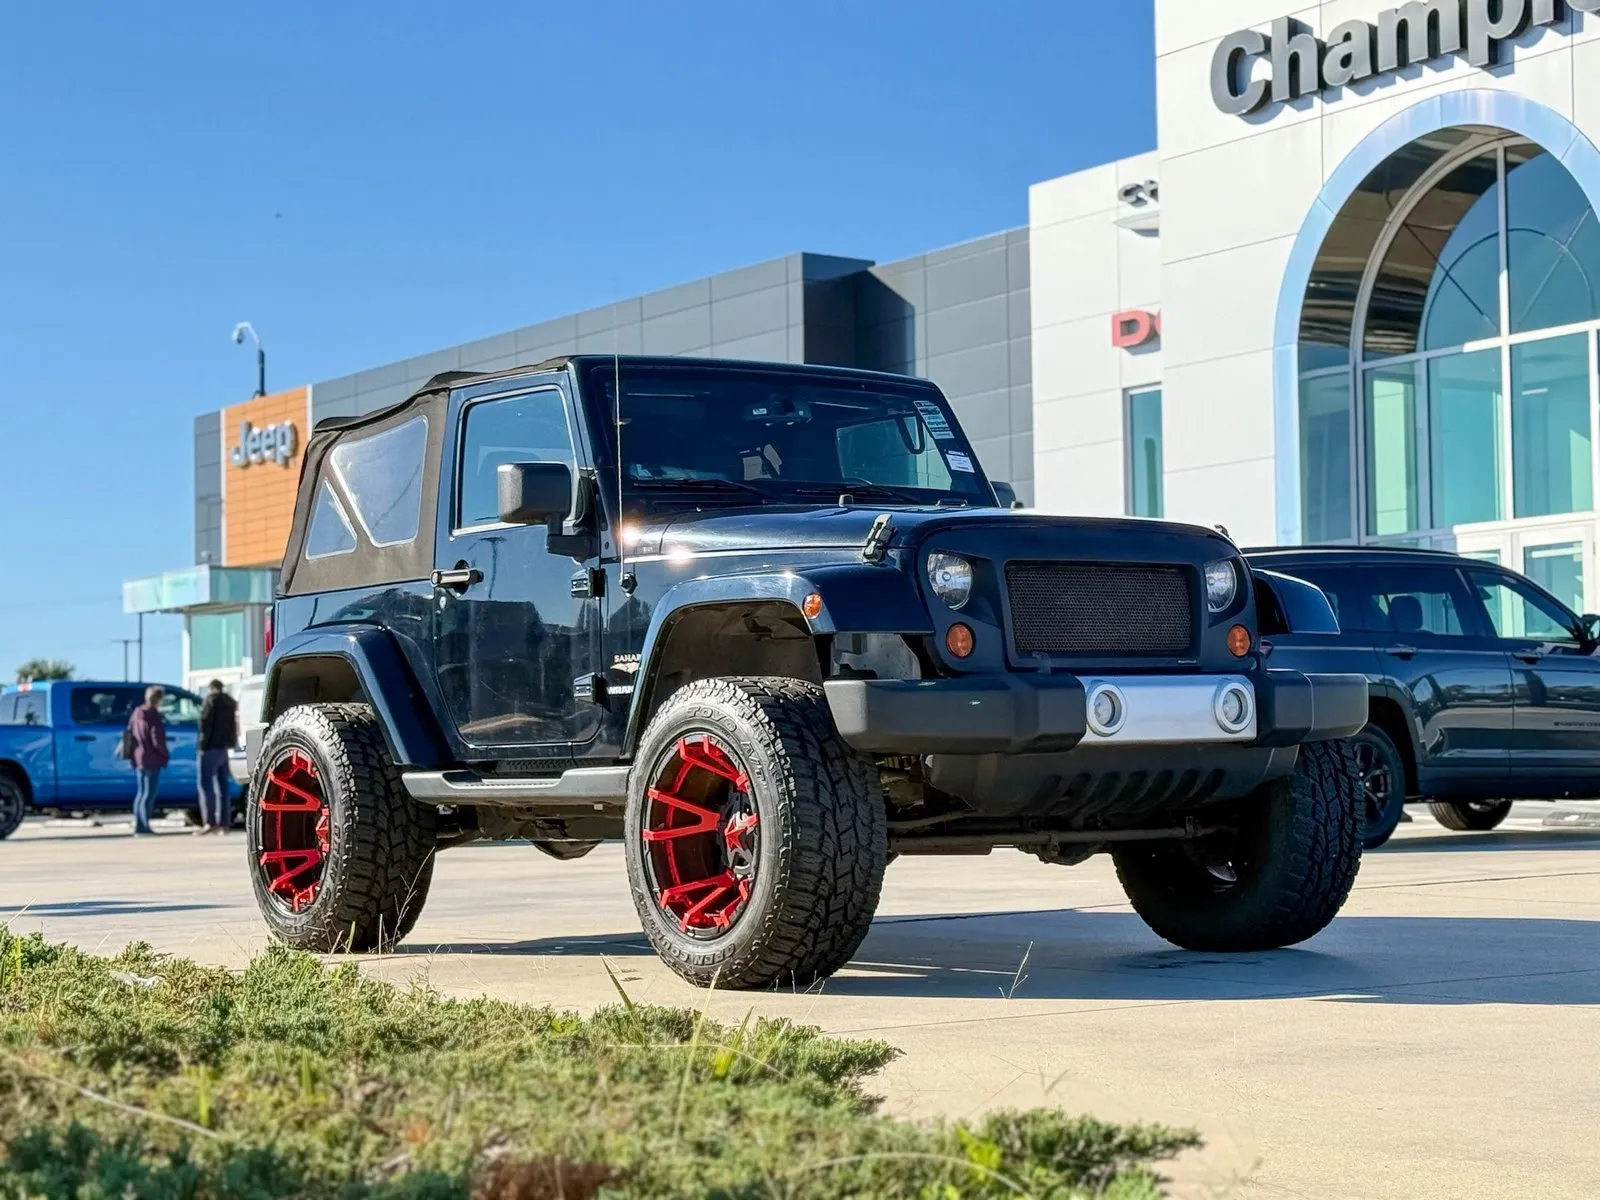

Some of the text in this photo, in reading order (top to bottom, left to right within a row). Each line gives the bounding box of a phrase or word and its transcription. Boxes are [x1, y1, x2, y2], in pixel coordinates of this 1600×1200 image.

[1210, 0, 1600, 116] Champ
[1111, 310, 1160, 348] D
[230, 421, 296, 467] Jeep
[687, 706, 737, 732] TOYO
[693, 943, 735, 965] OPEN
